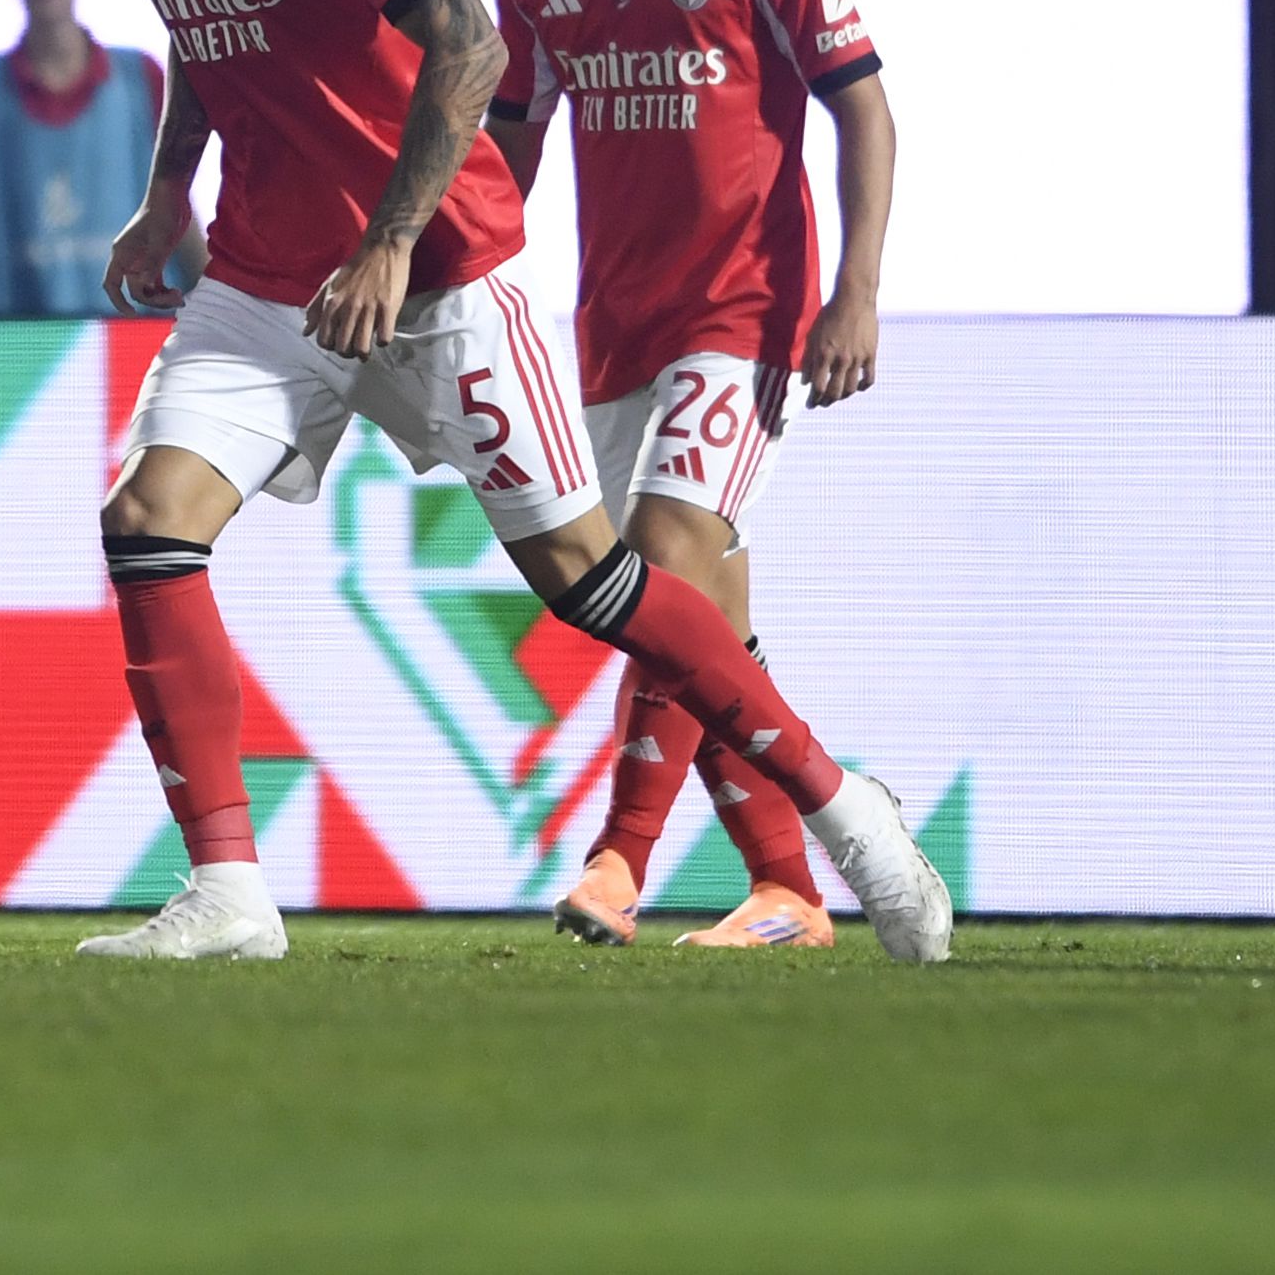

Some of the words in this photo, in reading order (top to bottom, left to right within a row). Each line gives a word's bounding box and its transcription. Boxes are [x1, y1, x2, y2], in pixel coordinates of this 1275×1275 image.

[815, 22, 869, 55] Beta
[614, 93, 698, 131] BETTER
[457, 367, 510, 454] 5
[655, 370, 740, 448] 26
